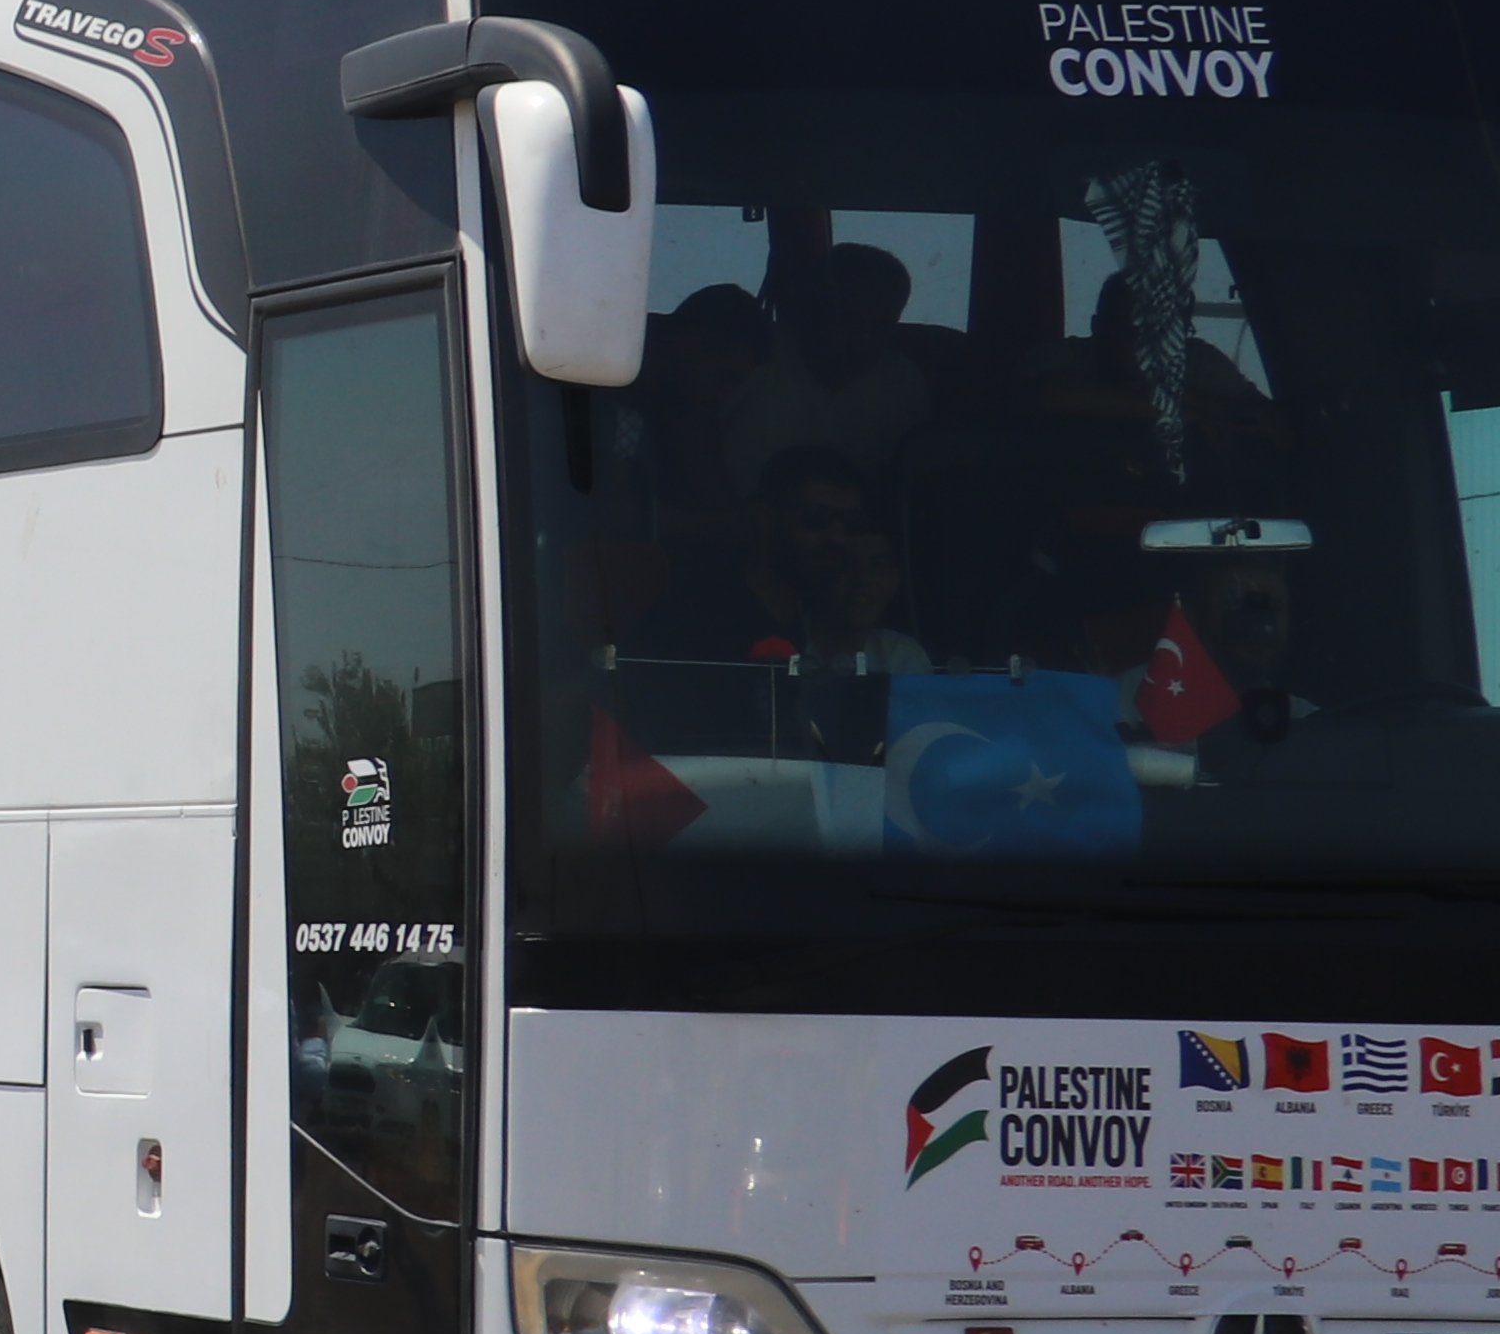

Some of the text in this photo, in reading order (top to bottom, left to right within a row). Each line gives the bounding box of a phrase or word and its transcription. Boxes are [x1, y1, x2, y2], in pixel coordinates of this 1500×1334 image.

[1039, 4, 1270, 44] PALESTINE
[23, 0, 186, 67] TRAVEGO S
[1049, 48, 1273, 98] CONVOY
[342, 805, 390, 826] PLESTINE
[342, 823, 391, 848] CONVOY
[296, 923, 455, 953] 0537 446 14 75
[1000, 1065, 1151, 1110] PALESTINE
[1196, 1100, 1233, 1113] BOSNIA
[1275, 1101, 1317, 1114] ALBANIA
[1357, 1102, 1394, 1115] GREECE
[1000, 1114, 1152, 1167] CONVOY
[1001, 1175, 1045, 1187] ANOTHER
[1078, 1175, 1122, 1187] ANOTHER
[950, 1280, 1005, 1291] BOSNIA AND
[1060, 1284, 1096, 1295] ALBANIA
[1168, 1285, 1200, 1296] GREECE
[945, 1294, 1008, 1306] HERZEGOVINA
